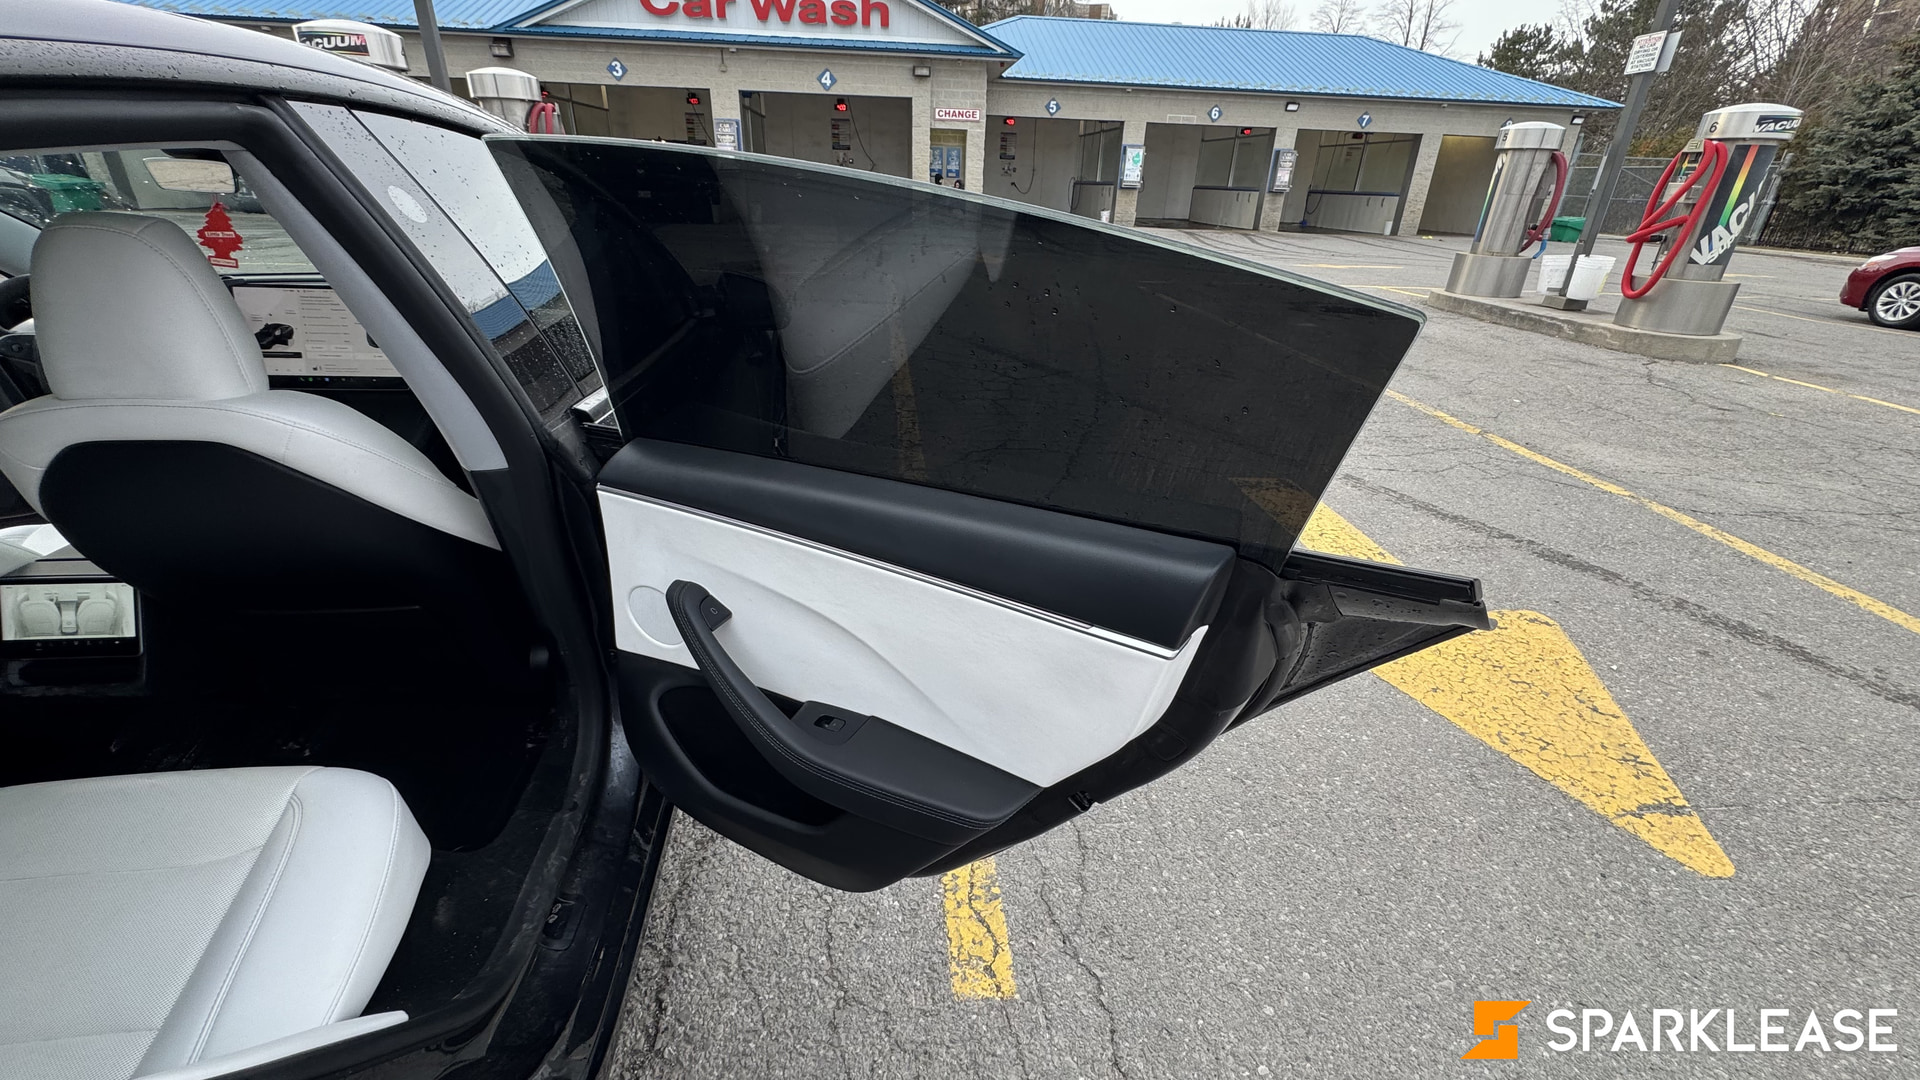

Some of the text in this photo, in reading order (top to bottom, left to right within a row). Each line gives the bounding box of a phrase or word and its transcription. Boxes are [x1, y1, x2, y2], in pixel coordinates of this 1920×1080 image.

[640, 0, 889, 27] Car Wash
[304, 35, 366, 48] ACUUM
[611, 61, 623, 76] 3
[821, 71, 831, 87] 4
[1049, 100, 1057, 113] 5
[1211, 107, 1219, 119] 6
[937, 109, 977, 119] CHANGE
[1362, 114, 1370, 127] 7
[1709, 121, 1719, 133] 6
[1754, 119, 1802, 133] VACUU
[1502, 131, 1509, 141] 5
